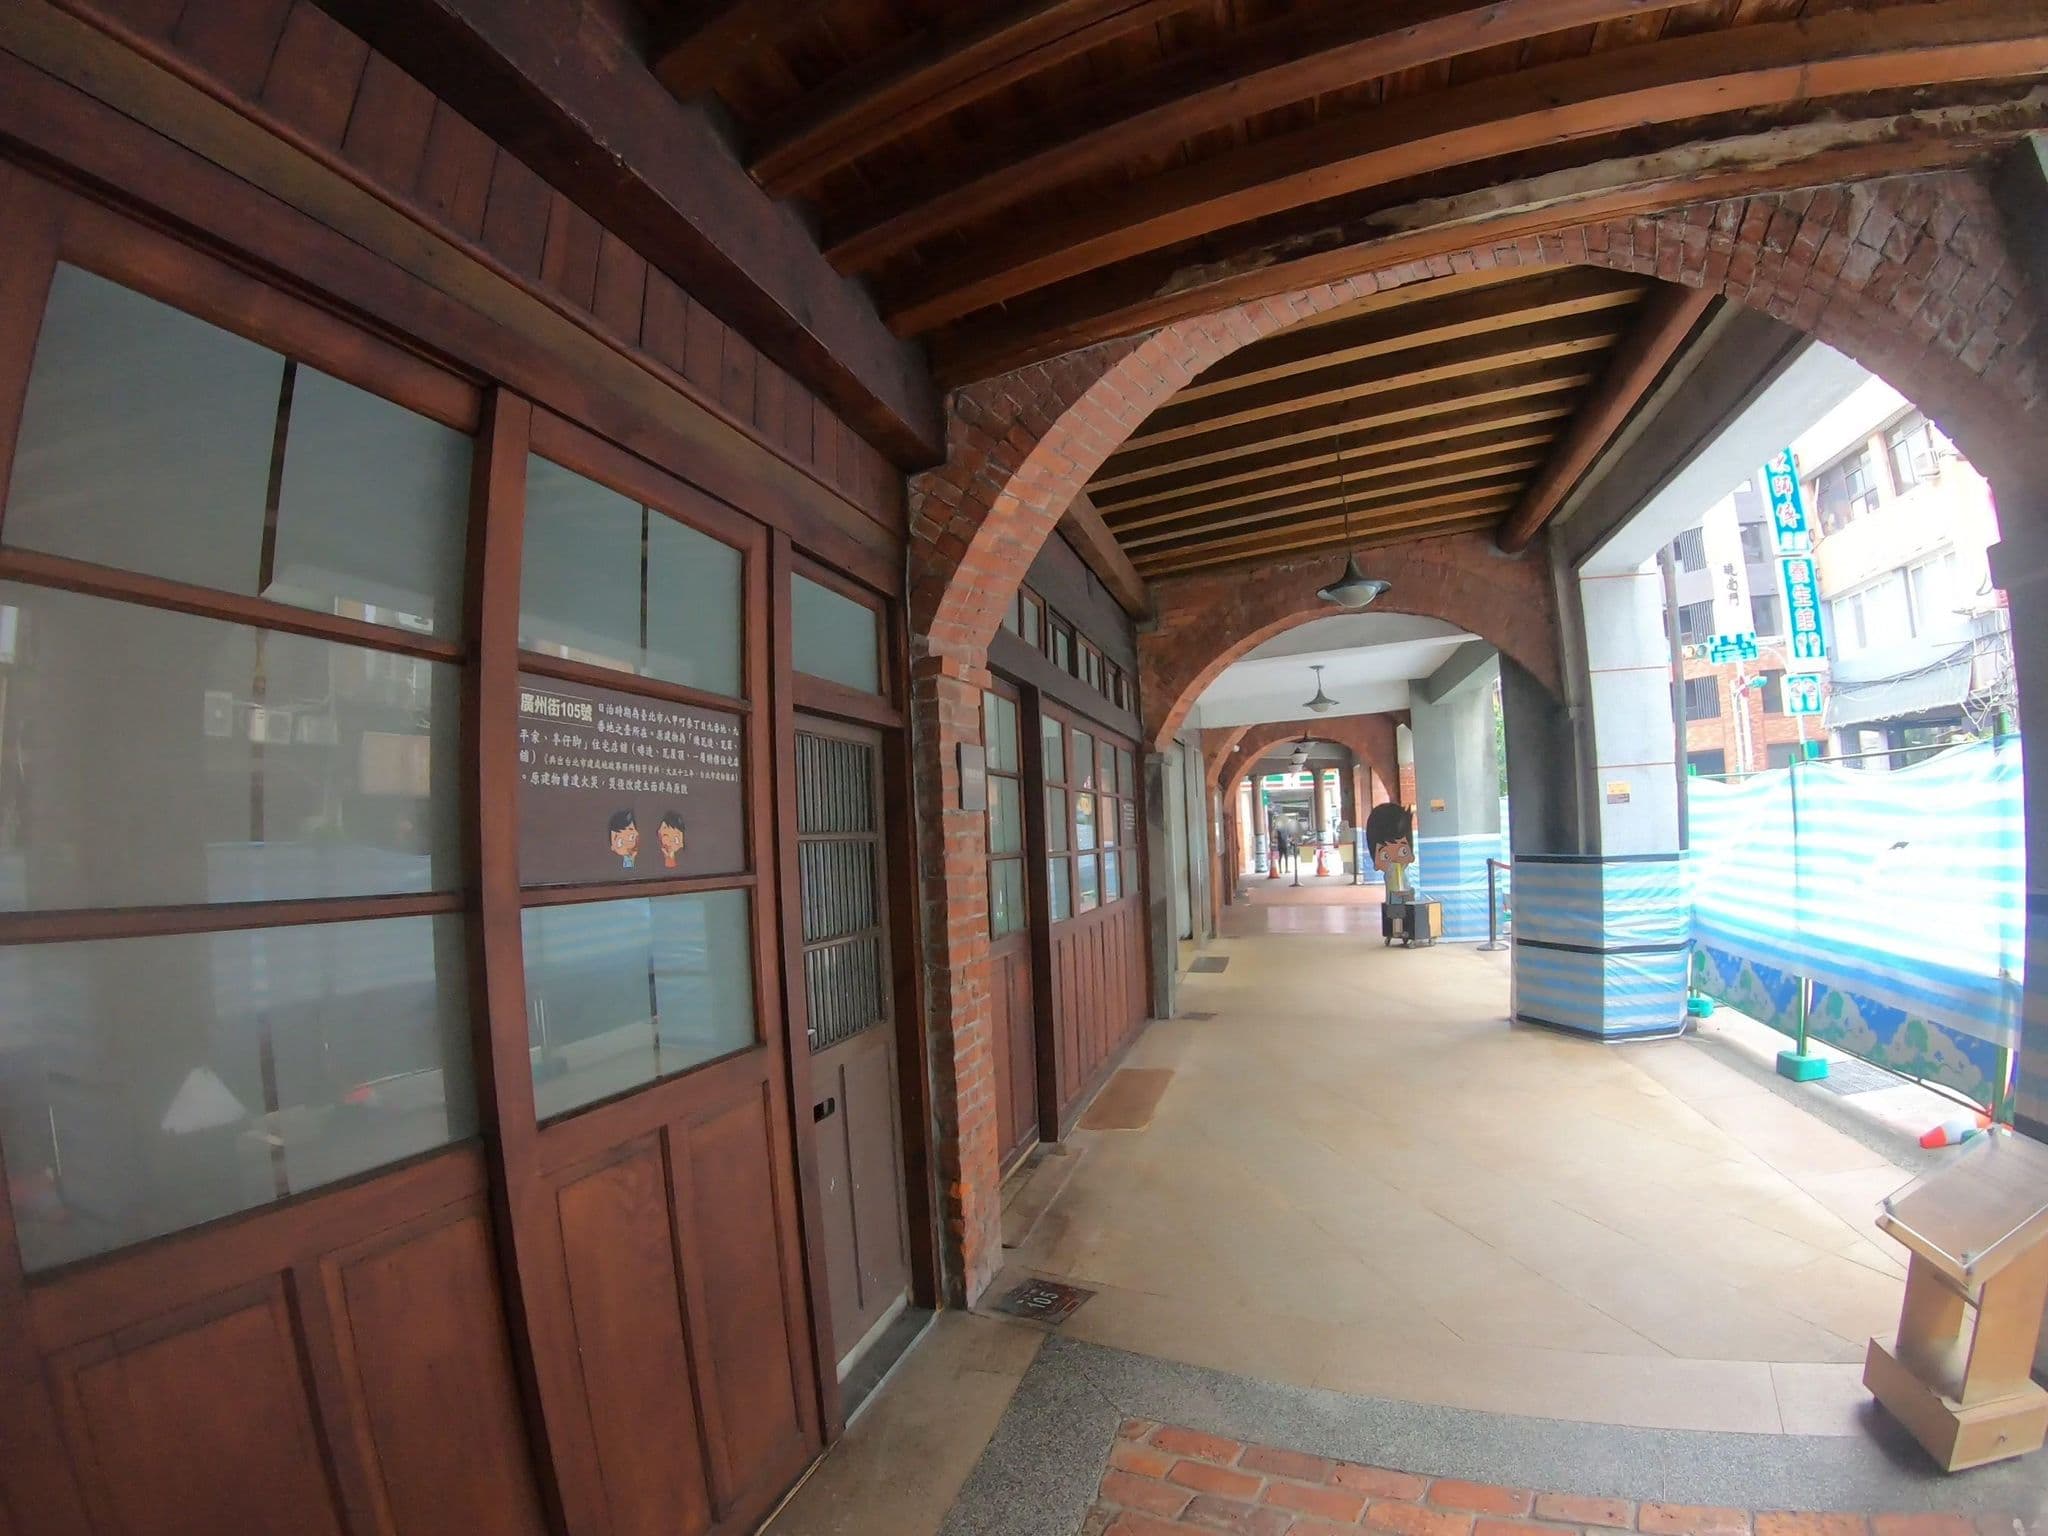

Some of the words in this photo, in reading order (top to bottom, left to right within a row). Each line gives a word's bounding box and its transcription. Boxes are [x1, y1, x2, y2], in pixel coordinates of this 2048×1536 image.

[1789, 560, 1816, 631] 養生館
[520, 693, 593, 722] 廣州街105號
[1027, 1292, 1058, 1308] 105
